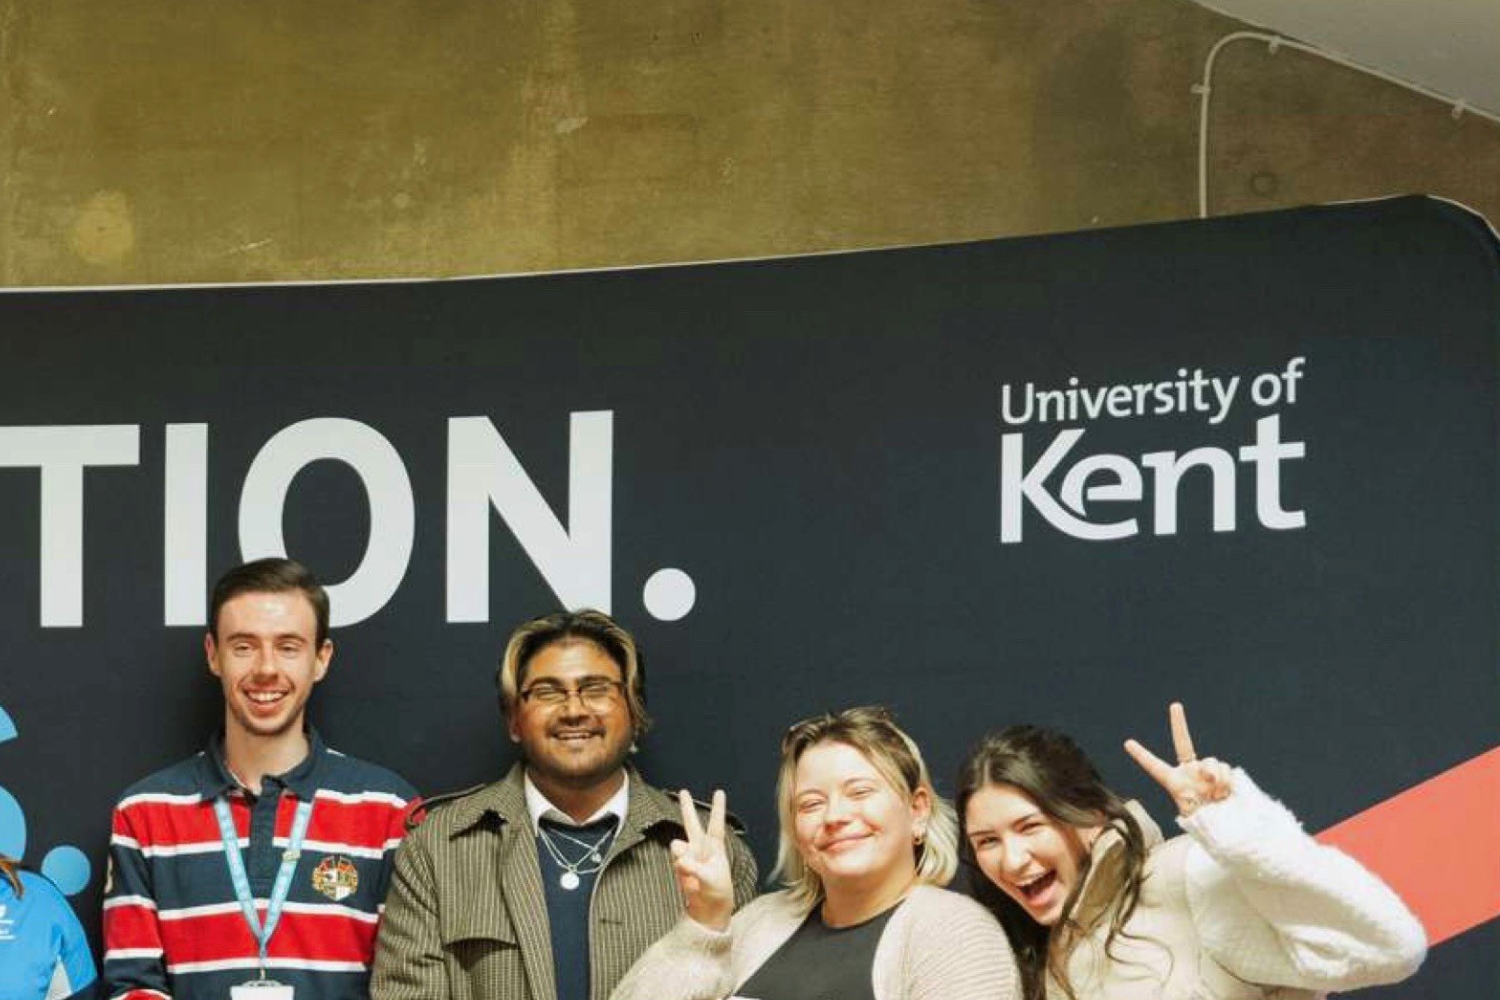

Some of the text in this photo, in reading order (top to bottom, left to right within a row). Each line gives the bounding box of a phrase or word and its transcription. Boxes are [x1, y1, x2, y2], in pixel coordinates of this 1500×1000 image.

[1001, 356, 1306, 424] University of
[1000, 413, 1307, 544] Kent
